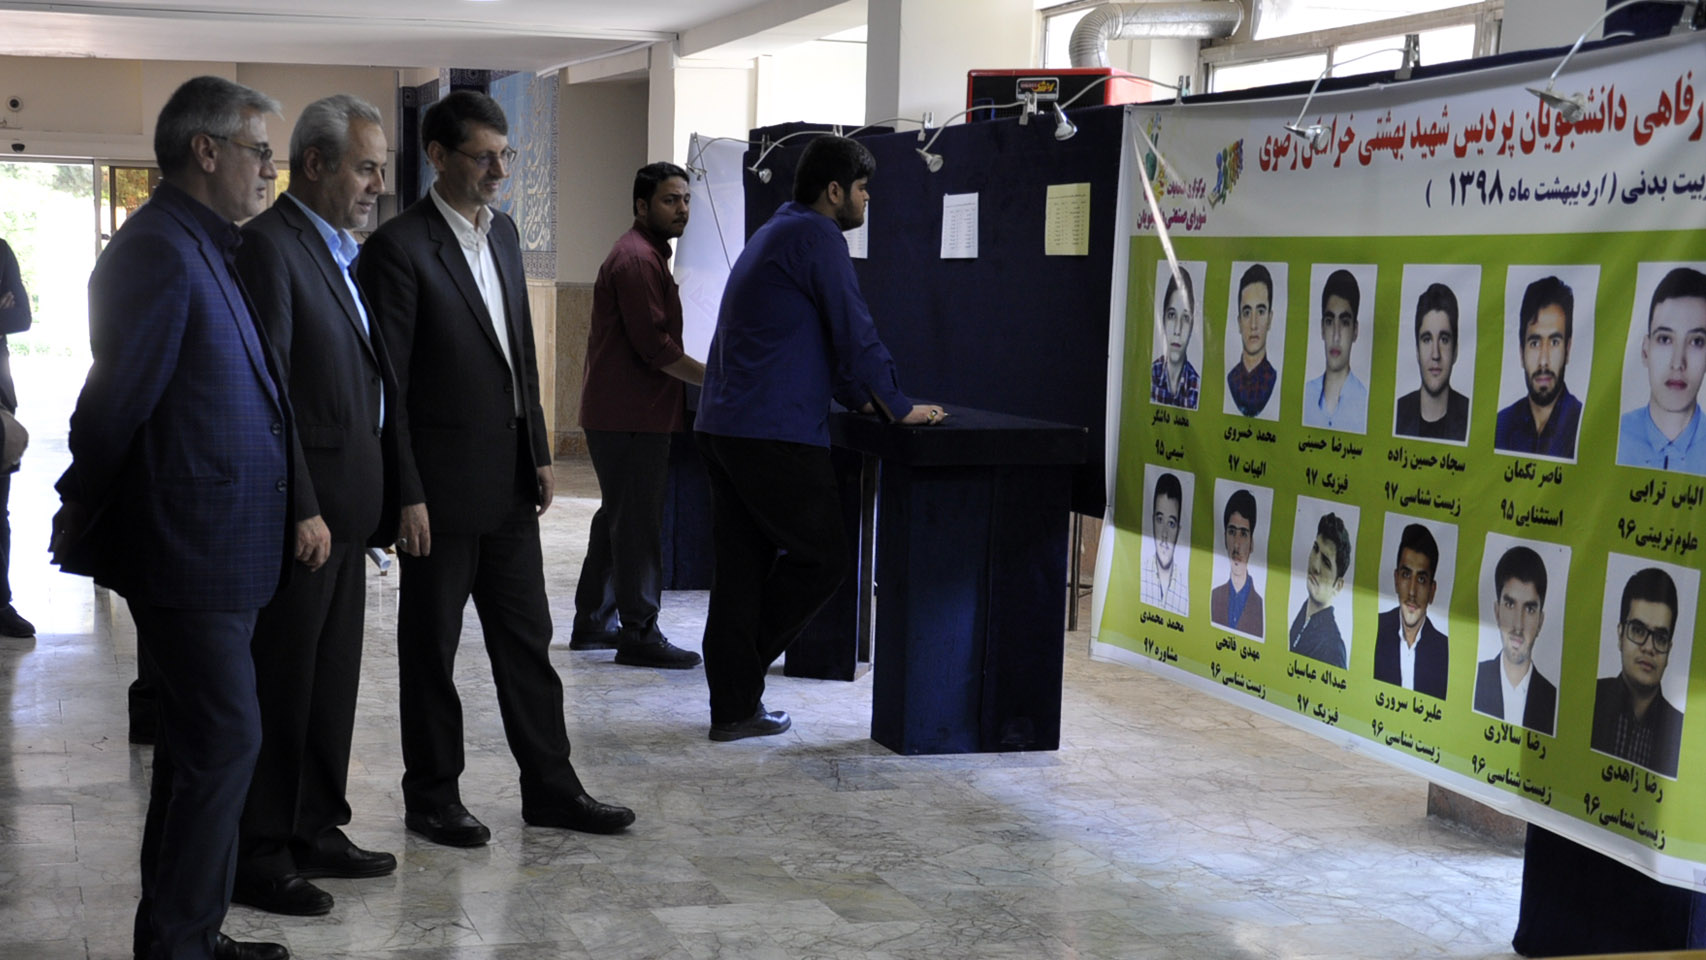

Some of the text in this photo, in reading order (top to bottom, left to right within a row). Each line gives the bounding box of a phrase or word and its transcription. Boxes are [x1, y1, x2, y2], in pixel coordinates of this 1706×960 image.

[1633, 70, 1704, 146] رفاهی
[1358, 110, 1406, 166] بهشتی
[1410, 105, 1449, 159] شهید
[1454, 107, 1514, 158] پردیس
[1449, 168, 1503, 207] ۱۳۹۸
[1508, 178, 1530, 201] ماه
[1621, 170, 1668, 204] بدنی
[1173, 414, 1189, 427] محمد
[1224, 424, 1277, 443] محمد خسروی
[1298, 434, 1327, 453] حسینی
[1228, 453, 1266, 478] الهیات ۹۷
[1440, 453, 1466, 475] سجاد
[1538, 465, 1563, 488] ناصر
[1306, 467, 1348, 495] فیزیک ۹۷
[1629, 479, 1704, 510] الیاس ترابی
[1384, 481, 1461, 516] زیست شناسی ۹۷
[1500, 498, 1563, 527] استثنایی ۹۵
[1618, 517, 1698, 555] علوم تربیتی ۹۶
[1140, 611, 1185, 633] محمد محمدی
[1144, 637, 1178, 662] مشاوره ۹۷
[1240, 646, 1261, 662] مهدی
[1210, 661, 1266, 700] زیست شناسی ۹۶
[1287, 660, 1347, 692] عبداله عباسیان
[1297, 693, 1339, 726] فیزیک ۹۷
[1375, 691, 1442, 722] علیرضا سروری
[1371, 718, 1441, 764] زیست شناسی ۹۶
[1484, 723, 1547, 760] رضا سالاری
[1471, 754, 1552, 805] زیست شناسی ۹۶
[1602, 764, 1664, 803] رضا زاهدی
[1583, 792, 1666, 850] زیست شناسی ۹۶
